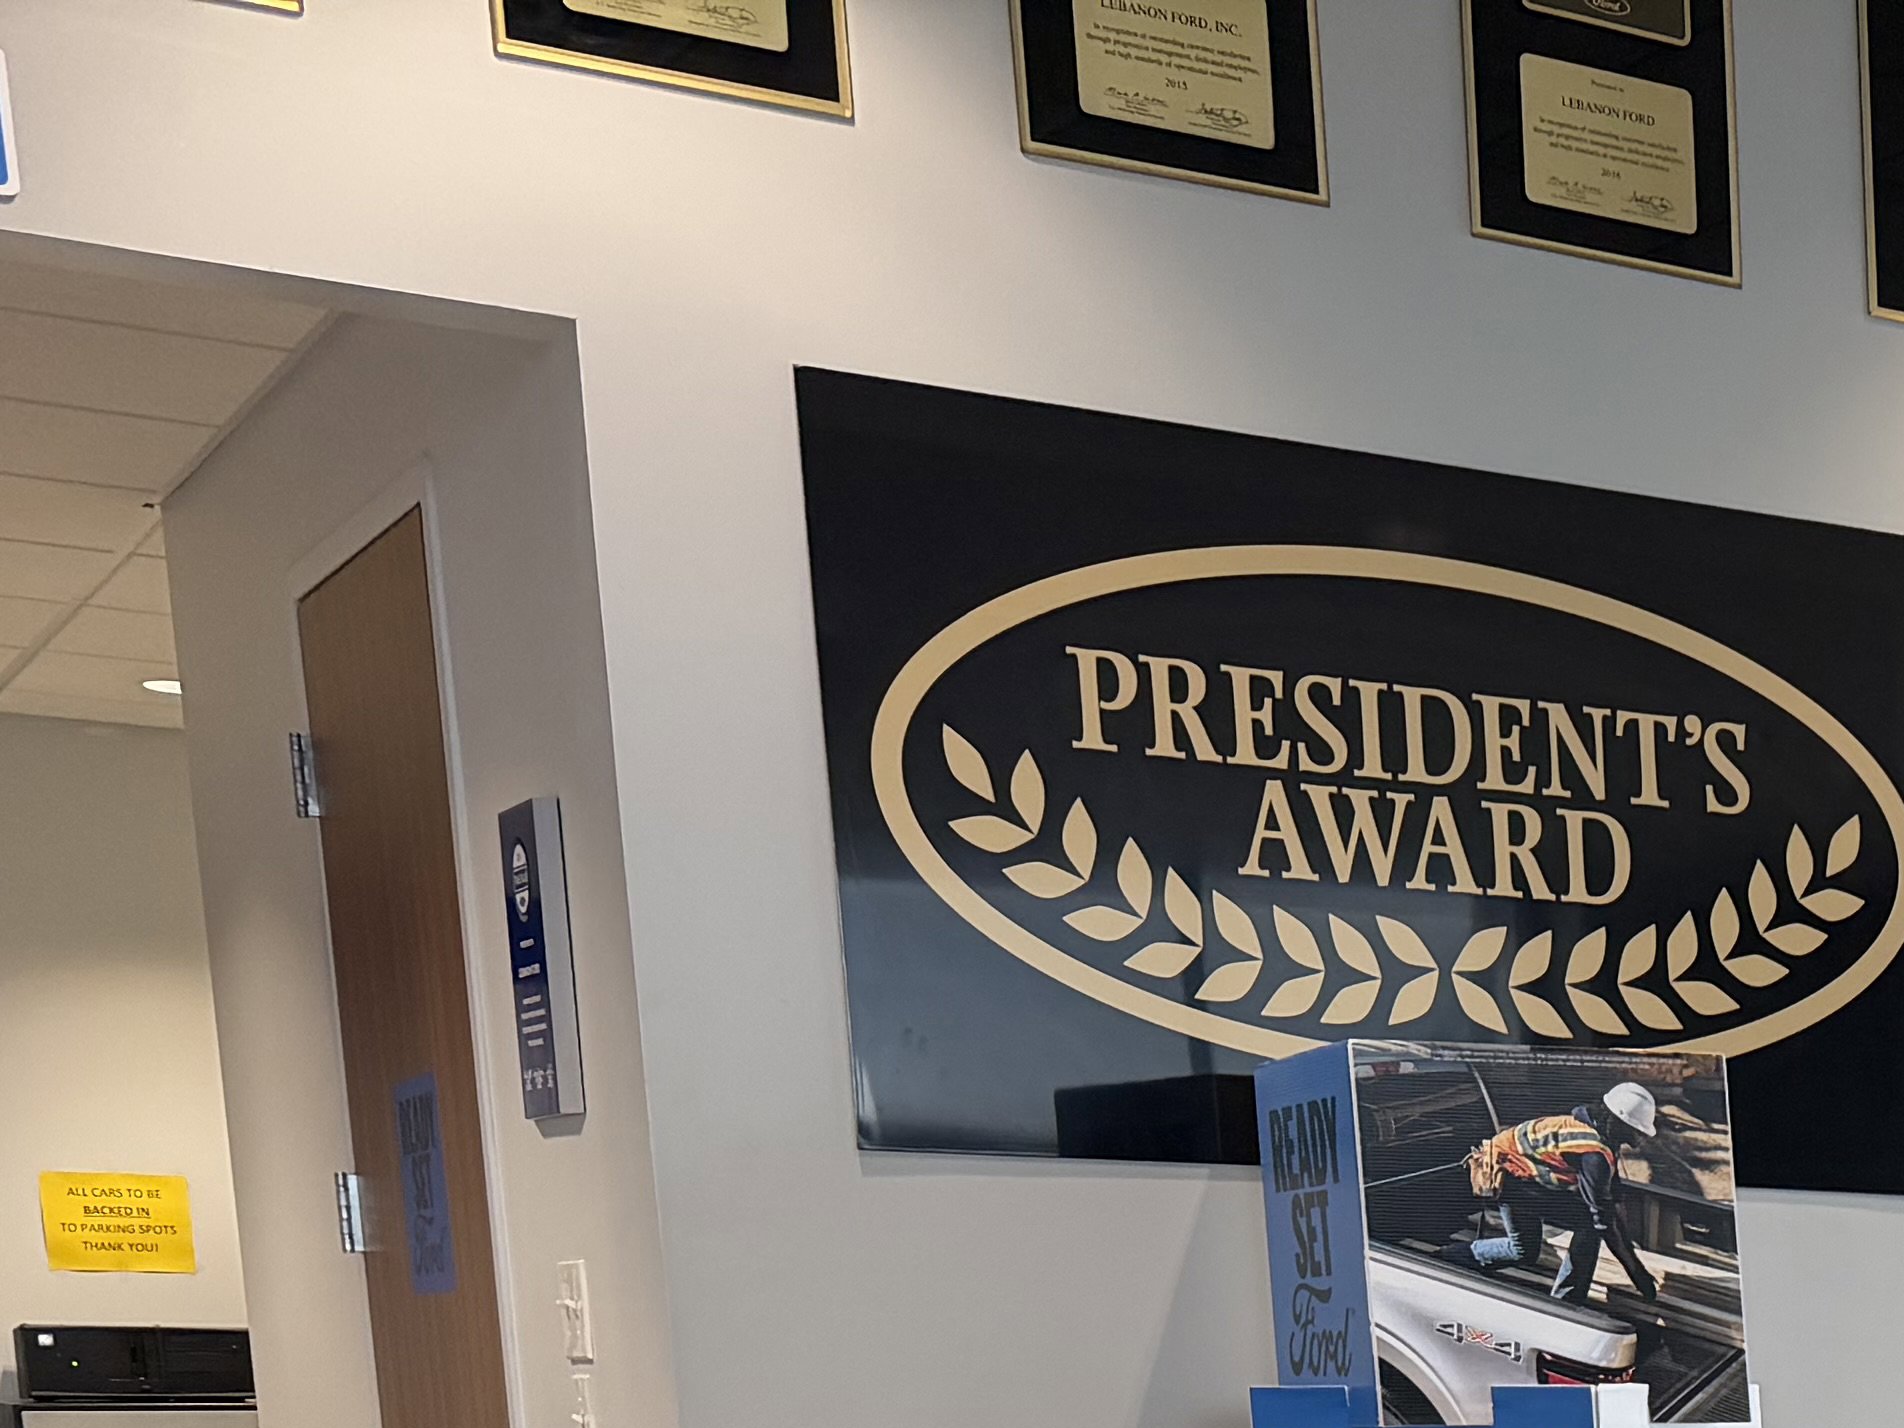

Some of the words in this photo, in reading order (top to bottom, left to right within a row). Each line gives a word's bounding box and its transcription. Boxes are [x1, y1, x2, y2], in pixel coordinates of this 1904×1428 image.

[1215, 20, 1242, 38] INC.
[1622, 110, 1656, 126] FORD
[1065, 644, 1752, 815] PRESIDENT'S
[1238, 779, 1633, 905] AWARD
[1268, 1095, 1340, 1194] READY
[66, 1187, 88, 1197] ALL
[91, 1187, 123, 1198] CARS
[126, 1188, 143, 1199] TO
[147, 1189, 162, 1200] BE
[83, 1205, 133, 1216] BACKED
[136, 1207, 150, 1216] IN
[60, 1222, 78, 1232] TO
[81, 1223, 136, 1234] PARKING
[139, 1224, 177, 1235] SPOTS
[1291, 1189, 1332, 1280] SET
[82, 1240, 124, 1252] THANK
[1289, 1283, 1353, 1378] Ford
